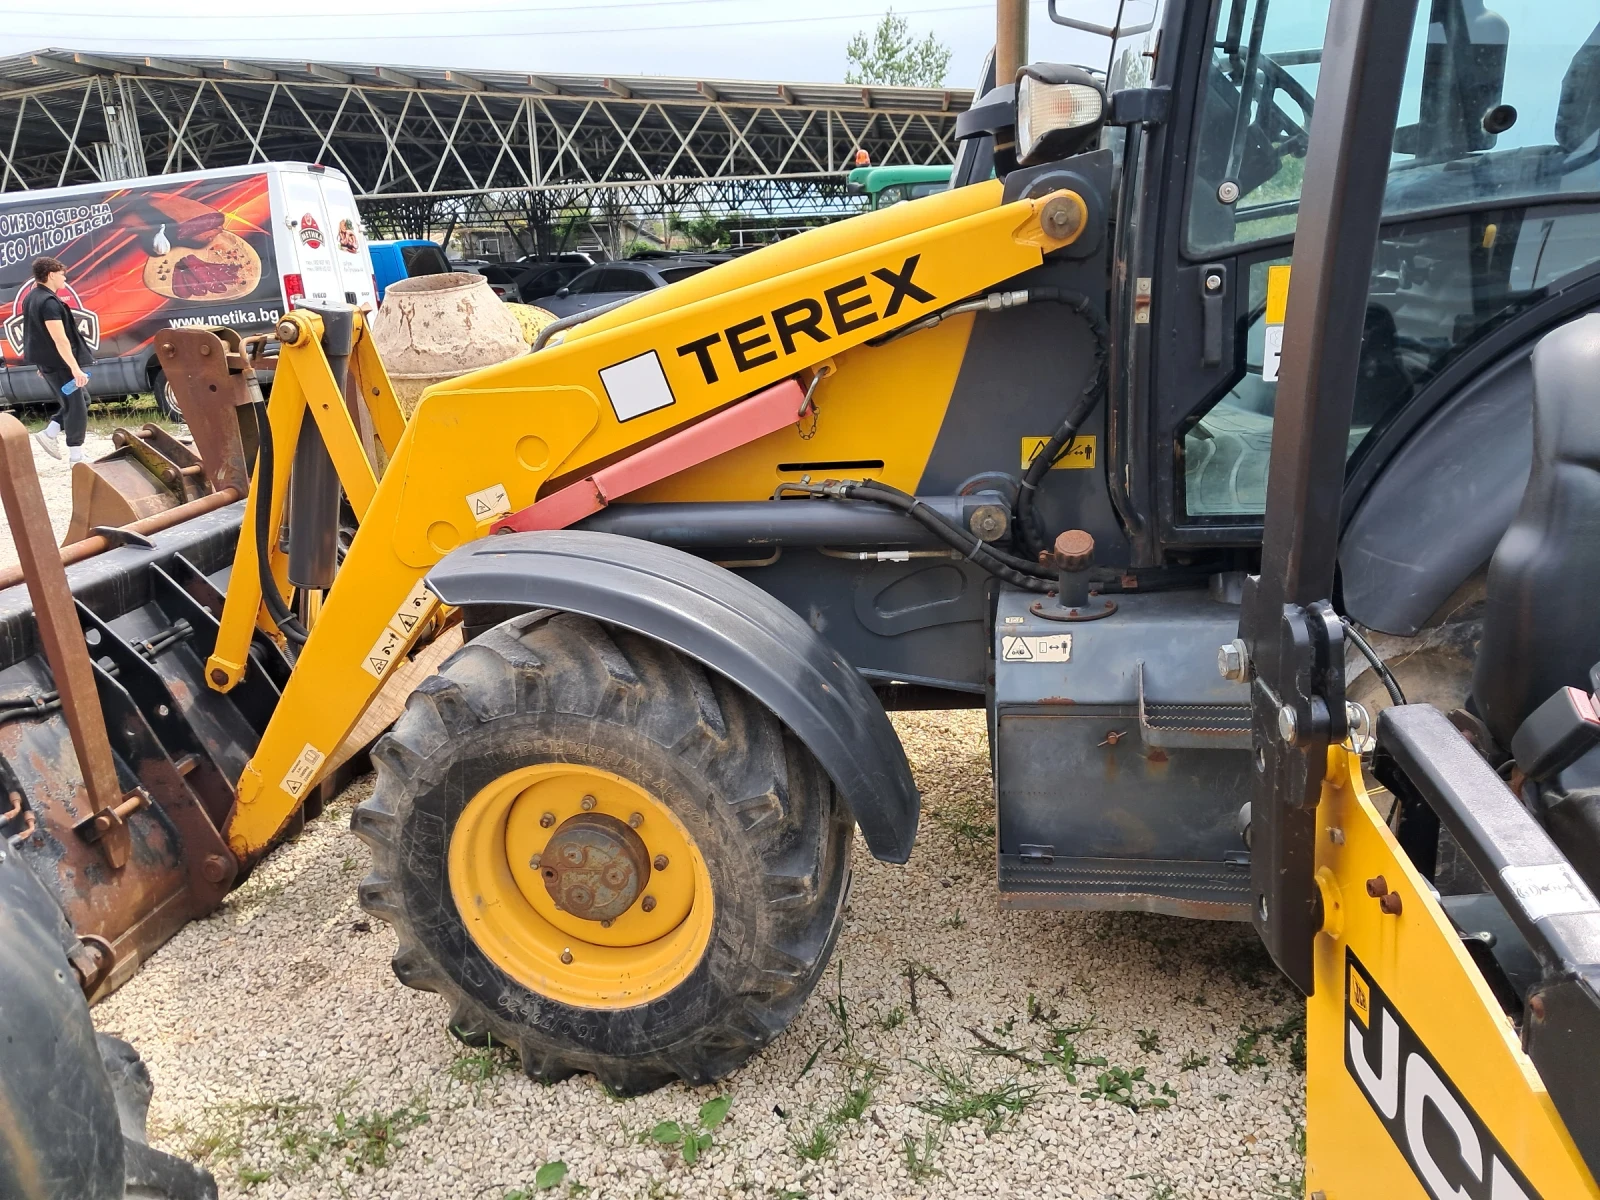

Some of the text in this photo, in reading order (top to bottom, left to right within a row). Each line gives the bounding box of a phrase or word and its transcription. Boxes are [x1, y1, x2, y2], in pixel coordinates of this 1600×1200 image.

[91, 203, 111, 217] НА
[28, 234, 42, 256] И
[43, 213, 114, 250] КОЛБАСИ
[169, 308, 280, 329] www.metika.bg
[676, 253, 938, 385] TEREX
